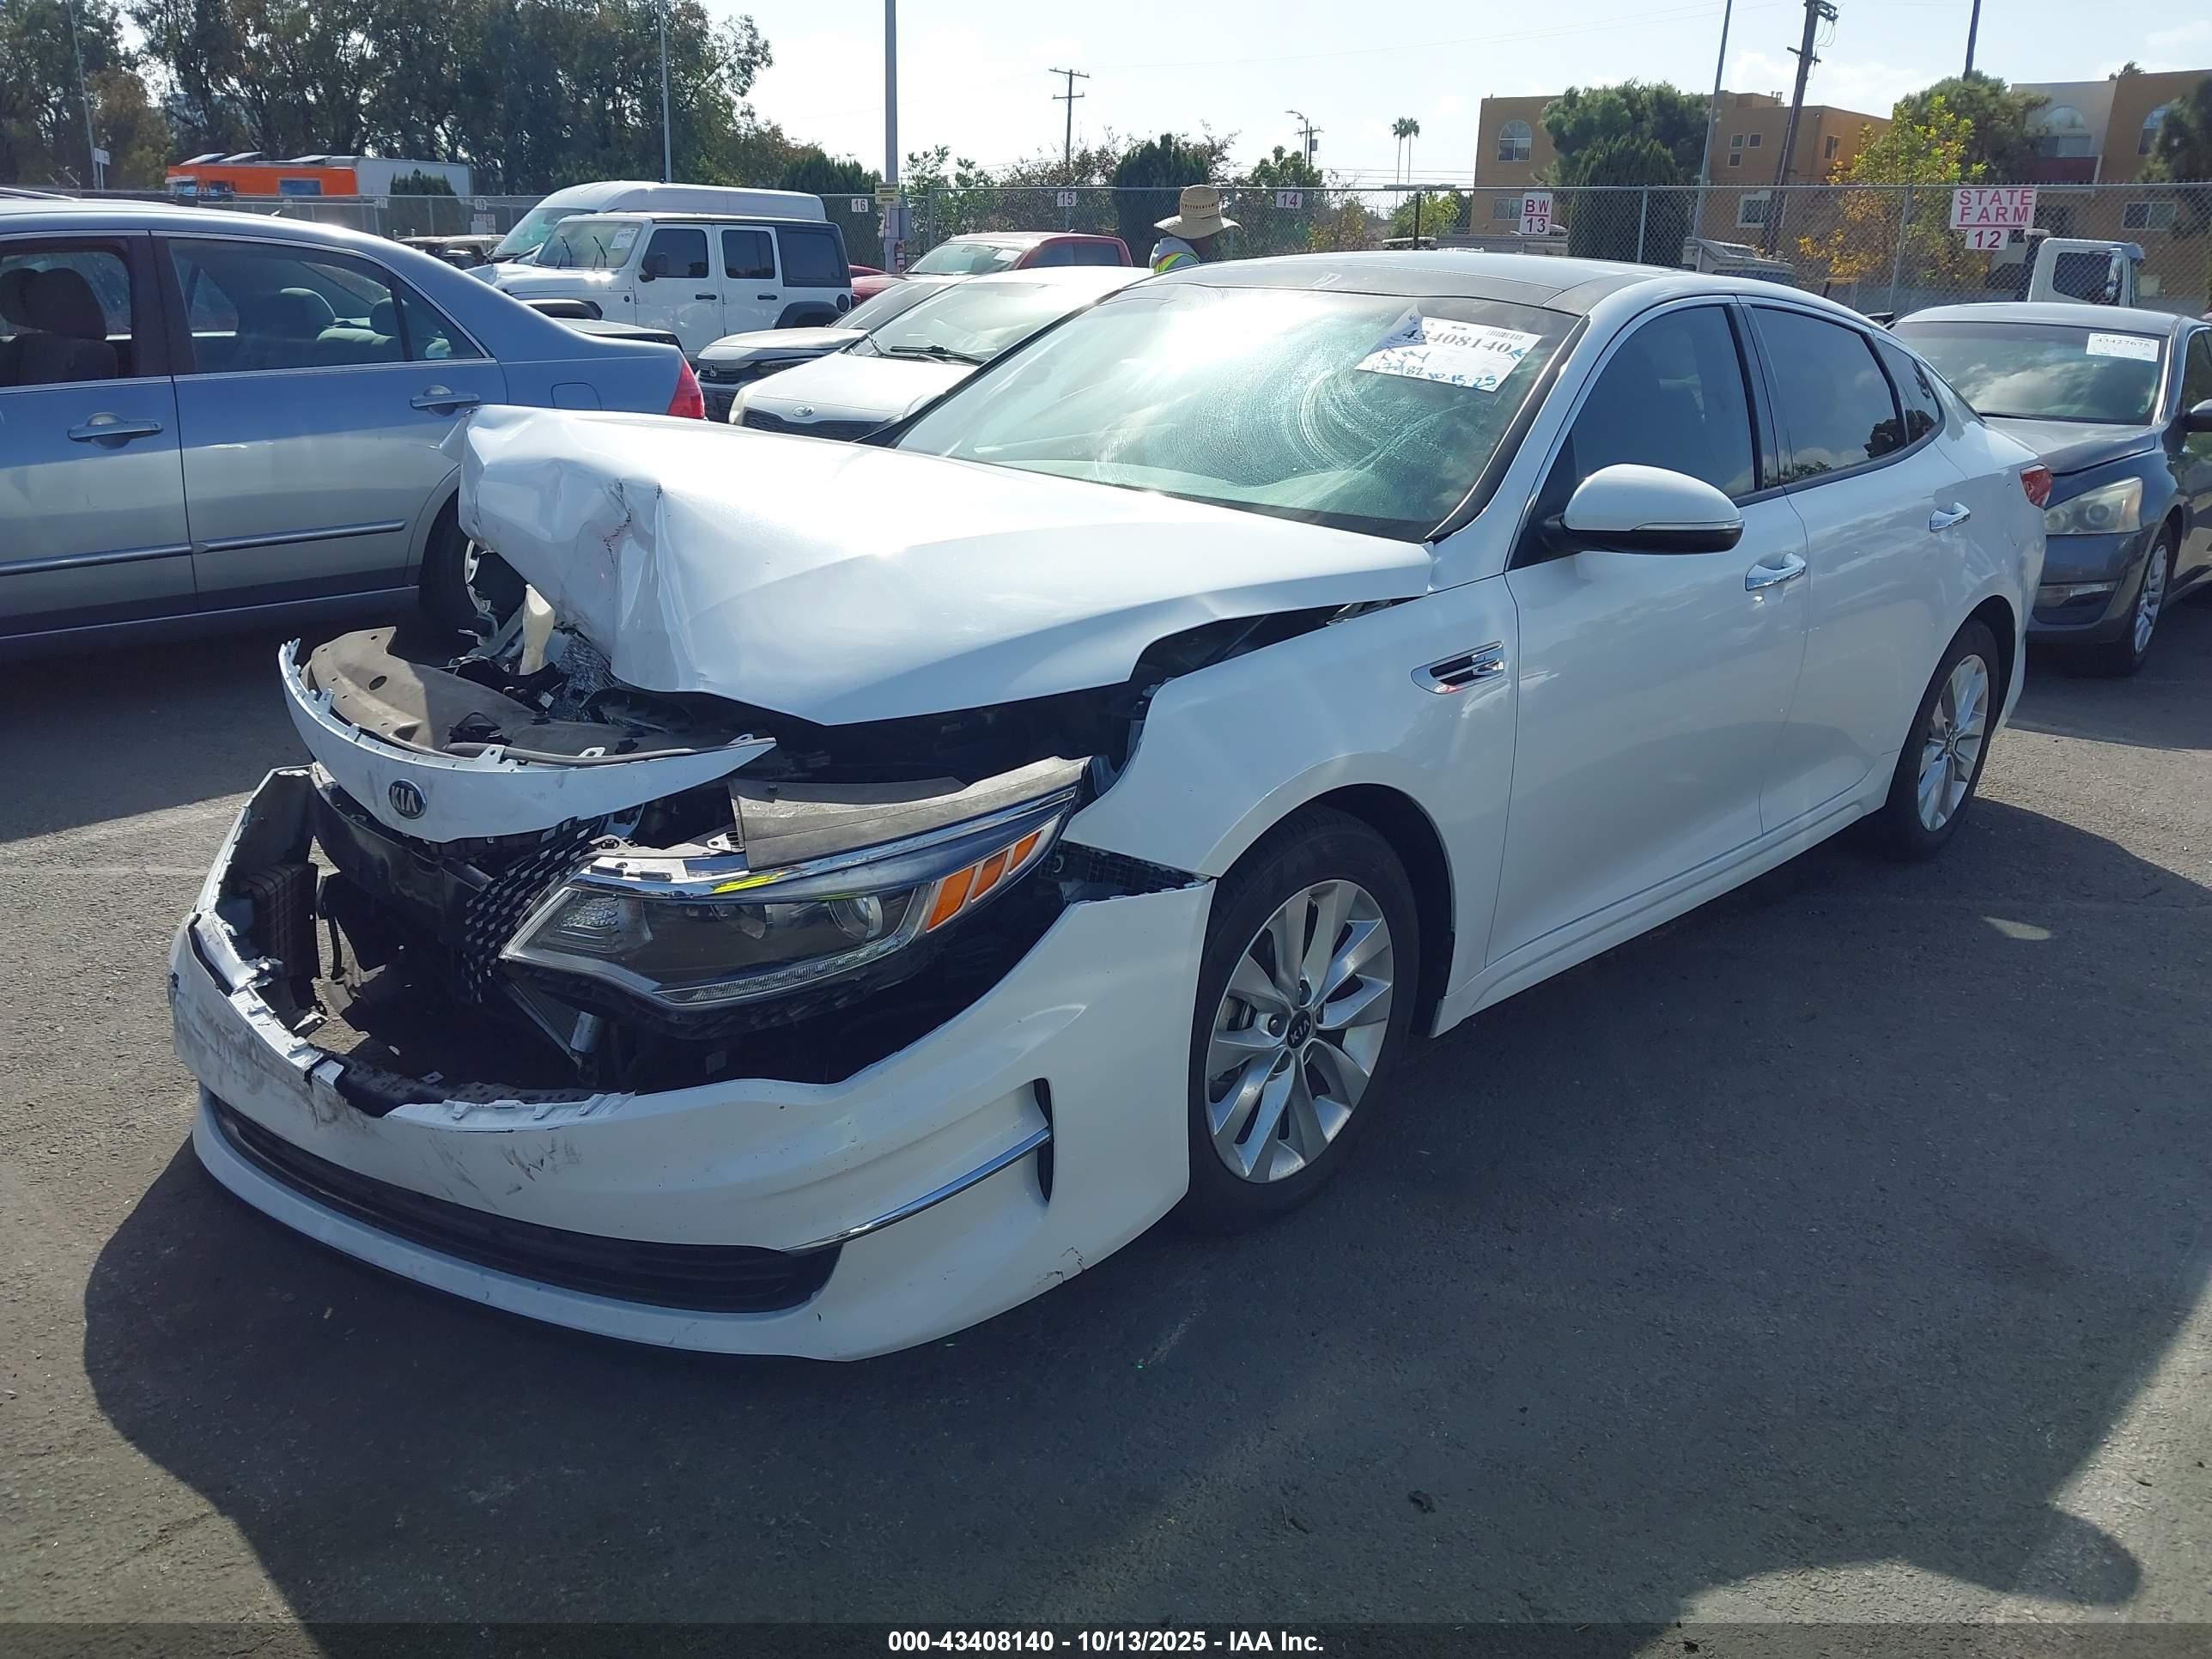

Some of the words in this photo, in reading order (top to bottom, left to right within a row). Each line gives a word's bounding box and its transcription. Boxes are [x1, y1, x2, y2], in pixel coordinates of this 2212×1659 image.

[1060, 193, 1073, 205] 15
[1282, 193, 1297, 207] 14
[1960, 189, 2033, 206] STATE
[854, 200, 866, 211] 16
[1525, 199, 1549, 213] BW
[1960, 206, 2029, 222] FARM
[1527, 218, 1546, 233] 13
[1974, 230, 2002, 249] 12
[392, 786, 418, 812] KIA
[1290, 1019, 1310, 1043] KIA
